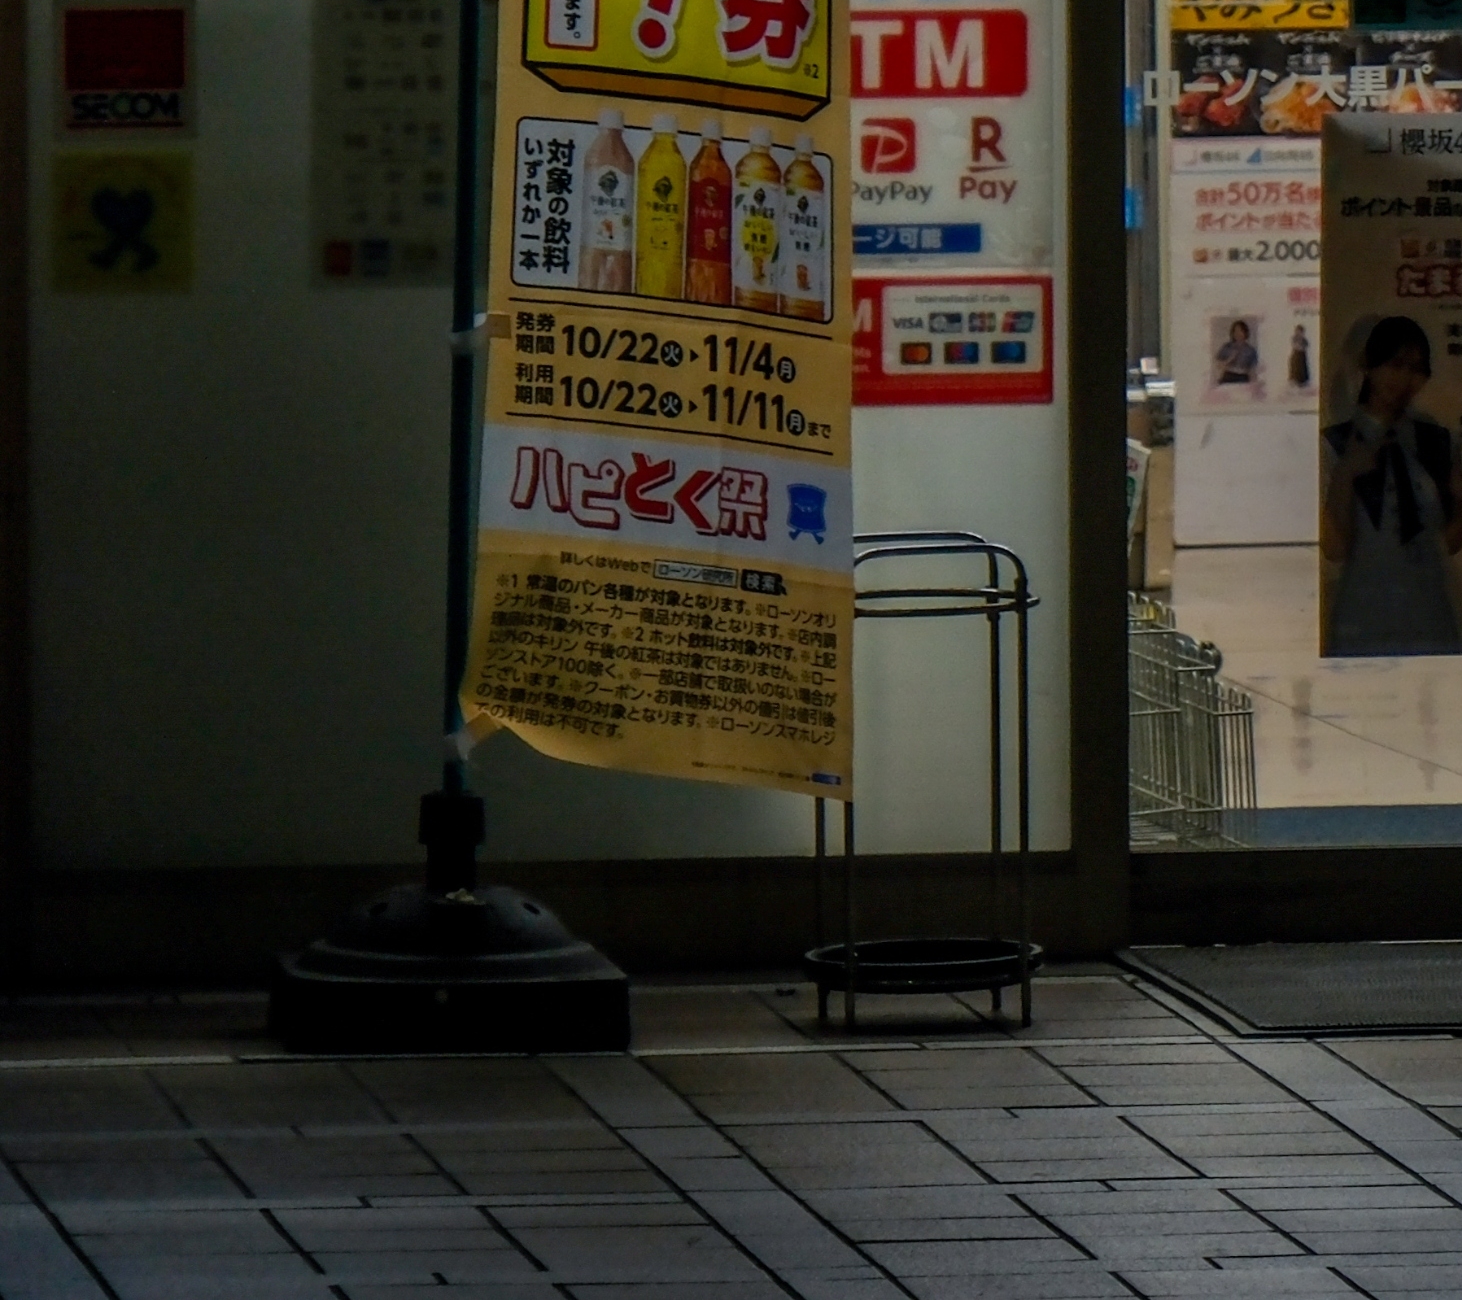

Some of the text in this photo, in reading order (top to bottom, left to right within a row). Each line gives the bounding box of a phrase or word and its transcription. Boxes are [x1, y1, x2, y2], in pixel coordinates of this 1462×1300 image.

[72, 93, 180, 120] SECOM
[959, 176, 1017, 204] Pay
[518, 138, 544, 272] いずれか一本
[541, 139, 575, 275] 対象の飲料
[516, 310, 556, 332] 発券
[515, 334, 555, 355] 期間
[515, 363, 554, 384] 利用
[514, 385, 554, 407] 期間
[807, 422, 832, 440] まで
[510, 446, 769, 541] ハピとく祭
